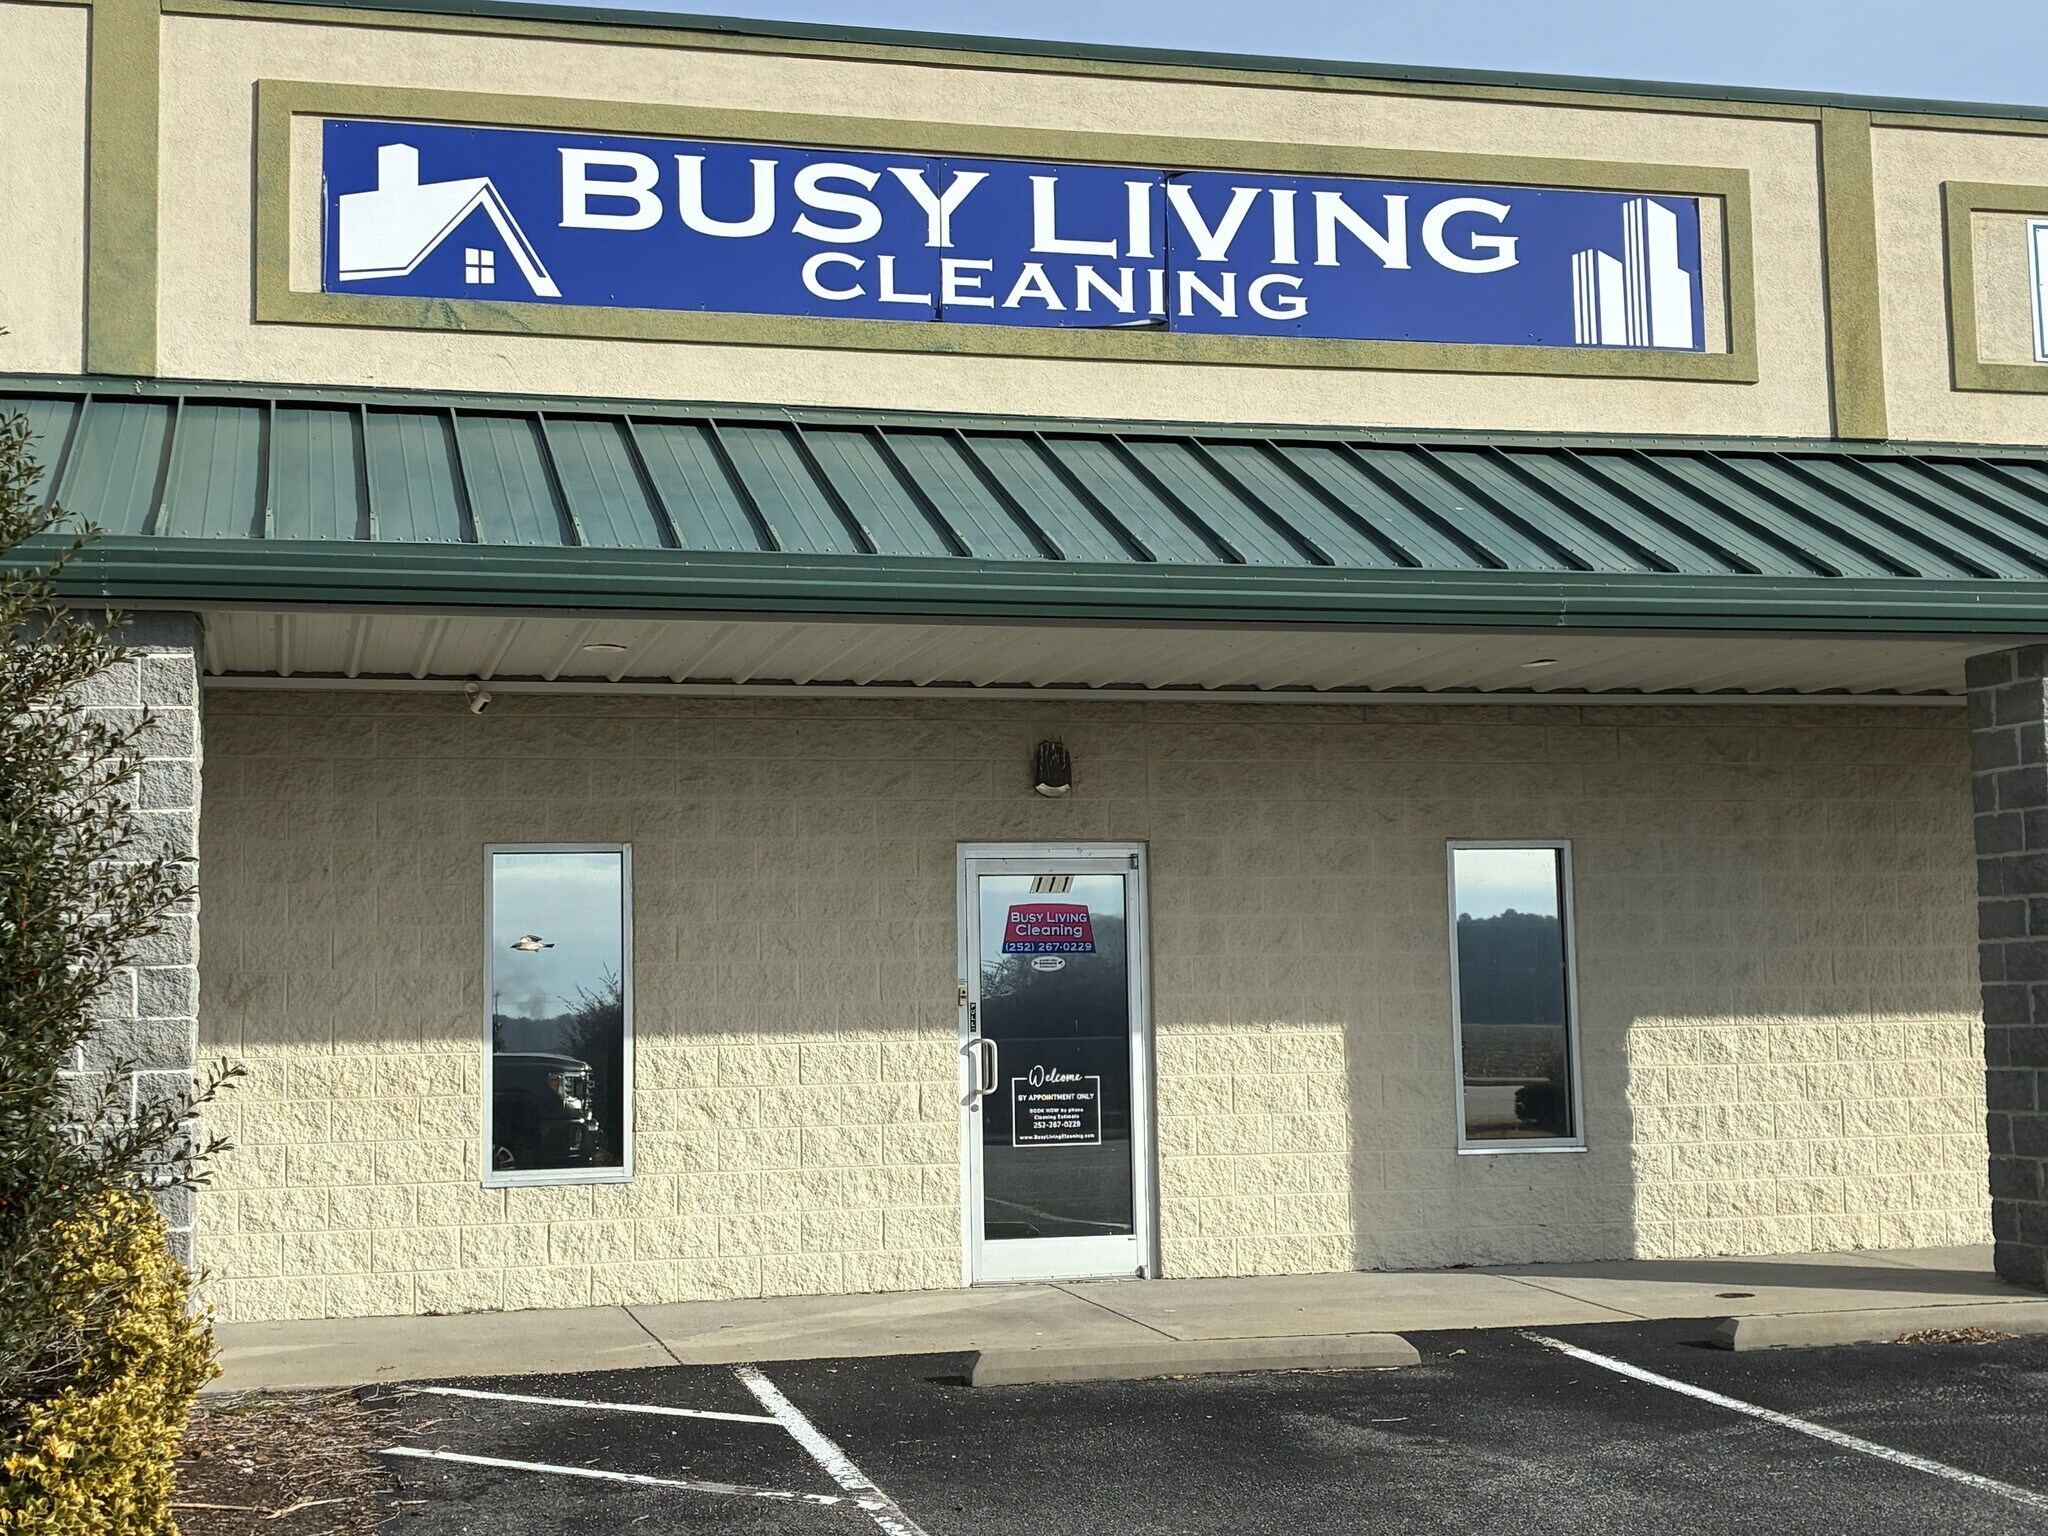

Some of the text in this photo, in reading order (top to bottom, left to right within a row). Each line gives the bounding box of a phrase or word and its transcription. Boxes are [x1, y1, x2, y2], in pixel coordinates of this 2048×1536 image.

[557, 147, 1520, 274] BUSY LIVING
[801, 252, 1309, 320] CLEANING
[1035, 876, 1070, 893] 111
[1011, 912, 1088, 923] BUSY LIVING
[1015, 924, 1083, 938] Cleaning
[1005, 942, 1035, 952] (252)
[1029, 1065, 1083, 1087] Welcome
[1018, 1094, 1028, 1102] BY
[1028, 1093, 1075, 1101] APPOINTMENT
